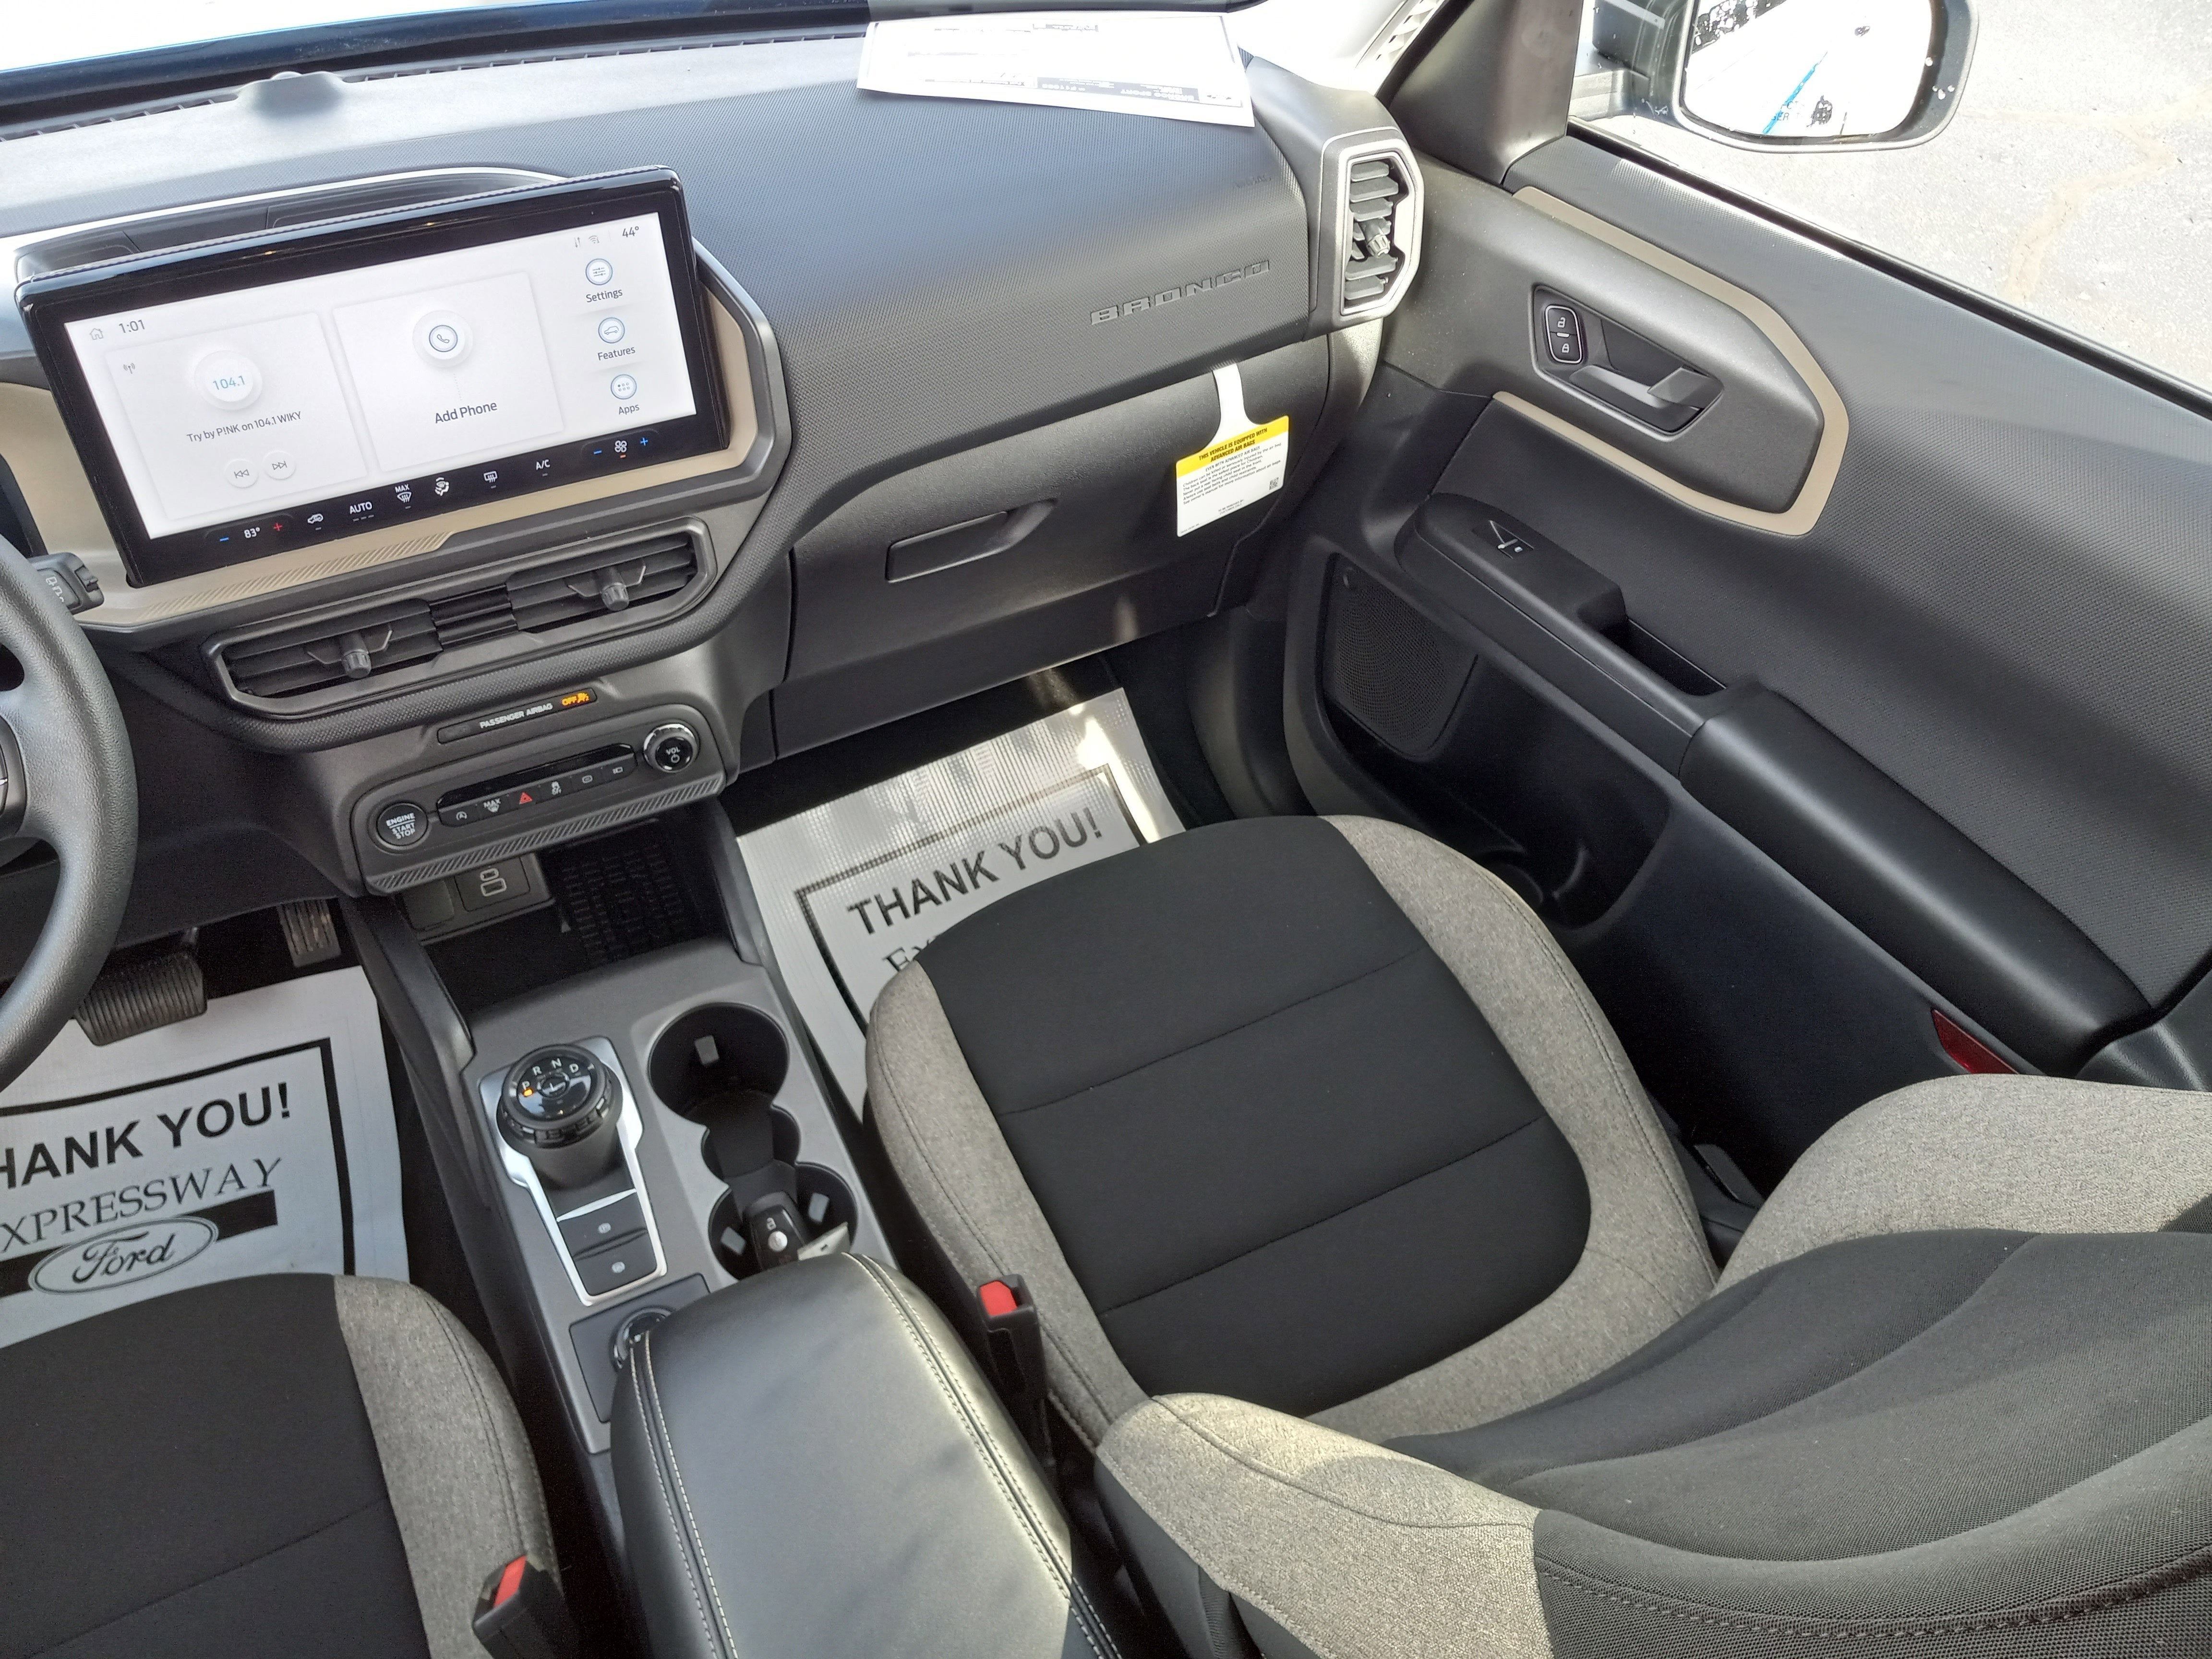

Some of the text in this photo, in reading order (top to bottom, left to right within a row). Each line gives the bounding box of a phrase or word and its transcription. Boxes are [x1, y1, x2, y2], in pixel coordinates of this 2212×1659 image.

[586, 289, 623, 303] Settings
[1090, 260, 1270, 325] BRONCO
[119, 319, 145, 334] 1:01
[597, 347, 636, 361] Features
[213, 375, 245, 390] 104.1
[434, 401, 497, 424] Add Phone
[618, 404, 640, 416] Apps
[186, 411, 301, 442] Try by P!NK on 104.1 WIKY
[1199, 452, 1209, 461] THIS
[1210, 444, 1227, 456] VEHICLE
[1234, 432, 1255, 445] EQUIPPED
[1256, 427, 1267, 437] WITH
[1211, 447, 1234, 462] ADVANCED
[1243, 438, 1255, 448] BAGS
[349, 501, 373, 516] AUTO
[395, 484, 410, 494] MAX
[536, 459, 551, 470] A/C
[480, 696, 577, 729] PASSENGER AIRBAG OFF
[665, 746, 681, 756] VOL
[483, 798, 501, 808] MAX
[386, 812, 416, 827] ENGINE
[392, 822, 415, 835] START
[395, 828, 416, 840] STOP
[848, 807, 1103, 935] THANK YOU!
[522, 1058, 579, 1091] P R N D
[0, 1082, 291, 1190] HANK YOU!
[0, 1157, 282, 1253] XPRESSWAY
[72, 1231, 176, 1284] Ford
